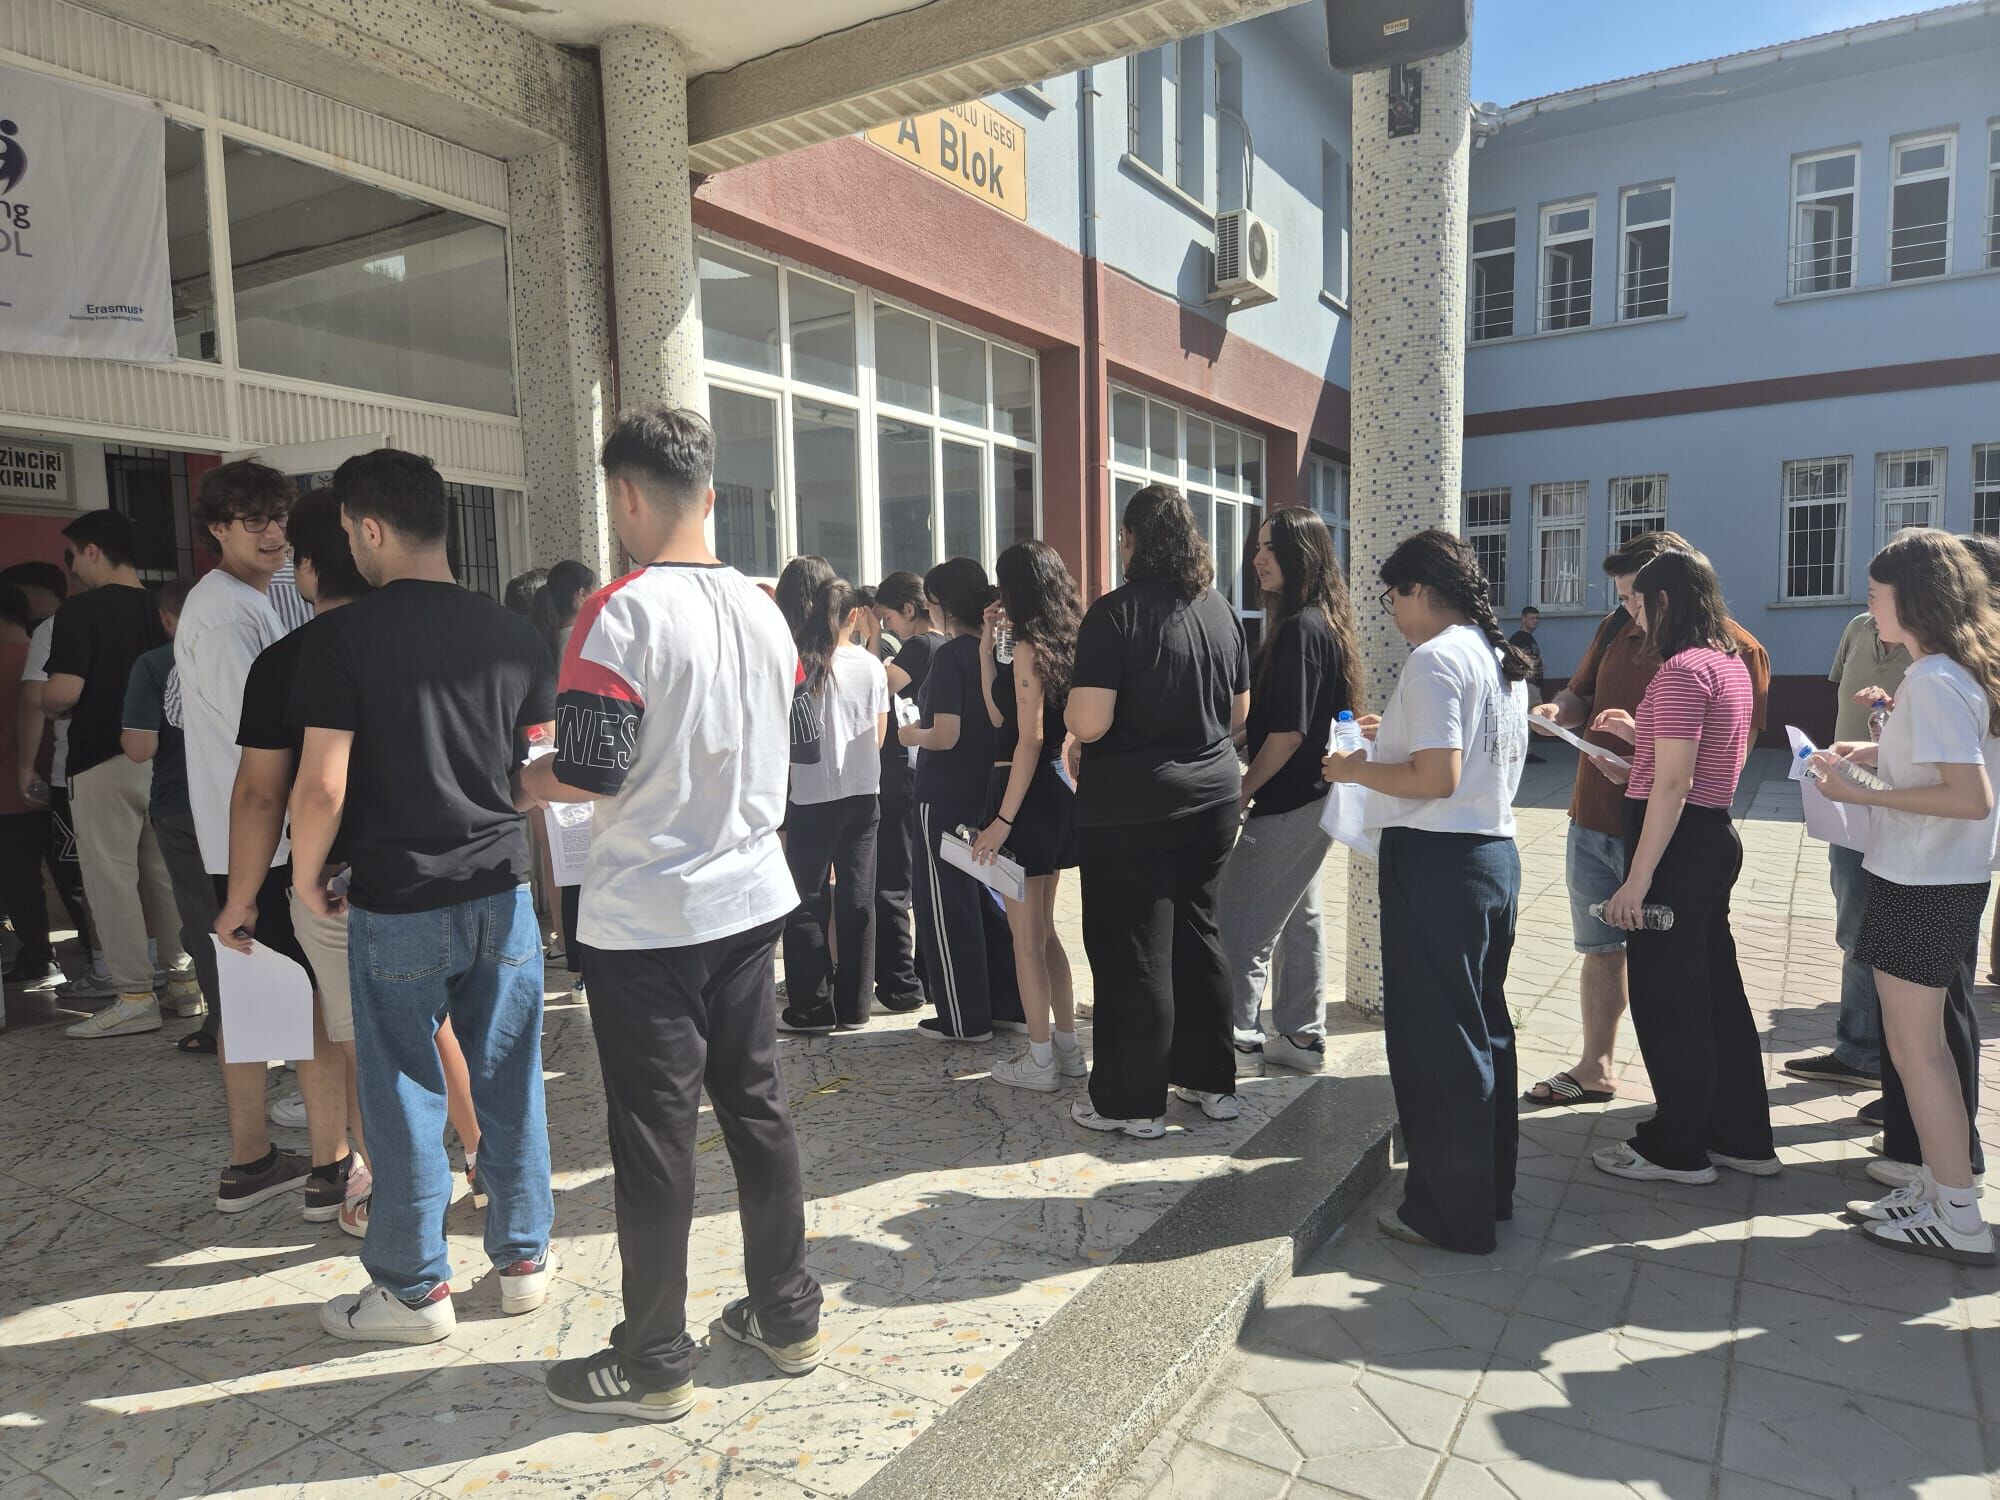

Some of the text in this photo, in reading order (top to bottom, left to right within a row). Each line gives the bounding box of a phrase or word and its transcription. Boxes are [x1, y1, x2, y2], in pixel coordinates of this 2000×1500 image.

[983, 112, 1016, 152] LİSESİ
[897, 117, 1004, 200] A Blok
[86, 303, 144, 315] Erasmus+
[0, 446, 62, 472] ZİNCİRİ
